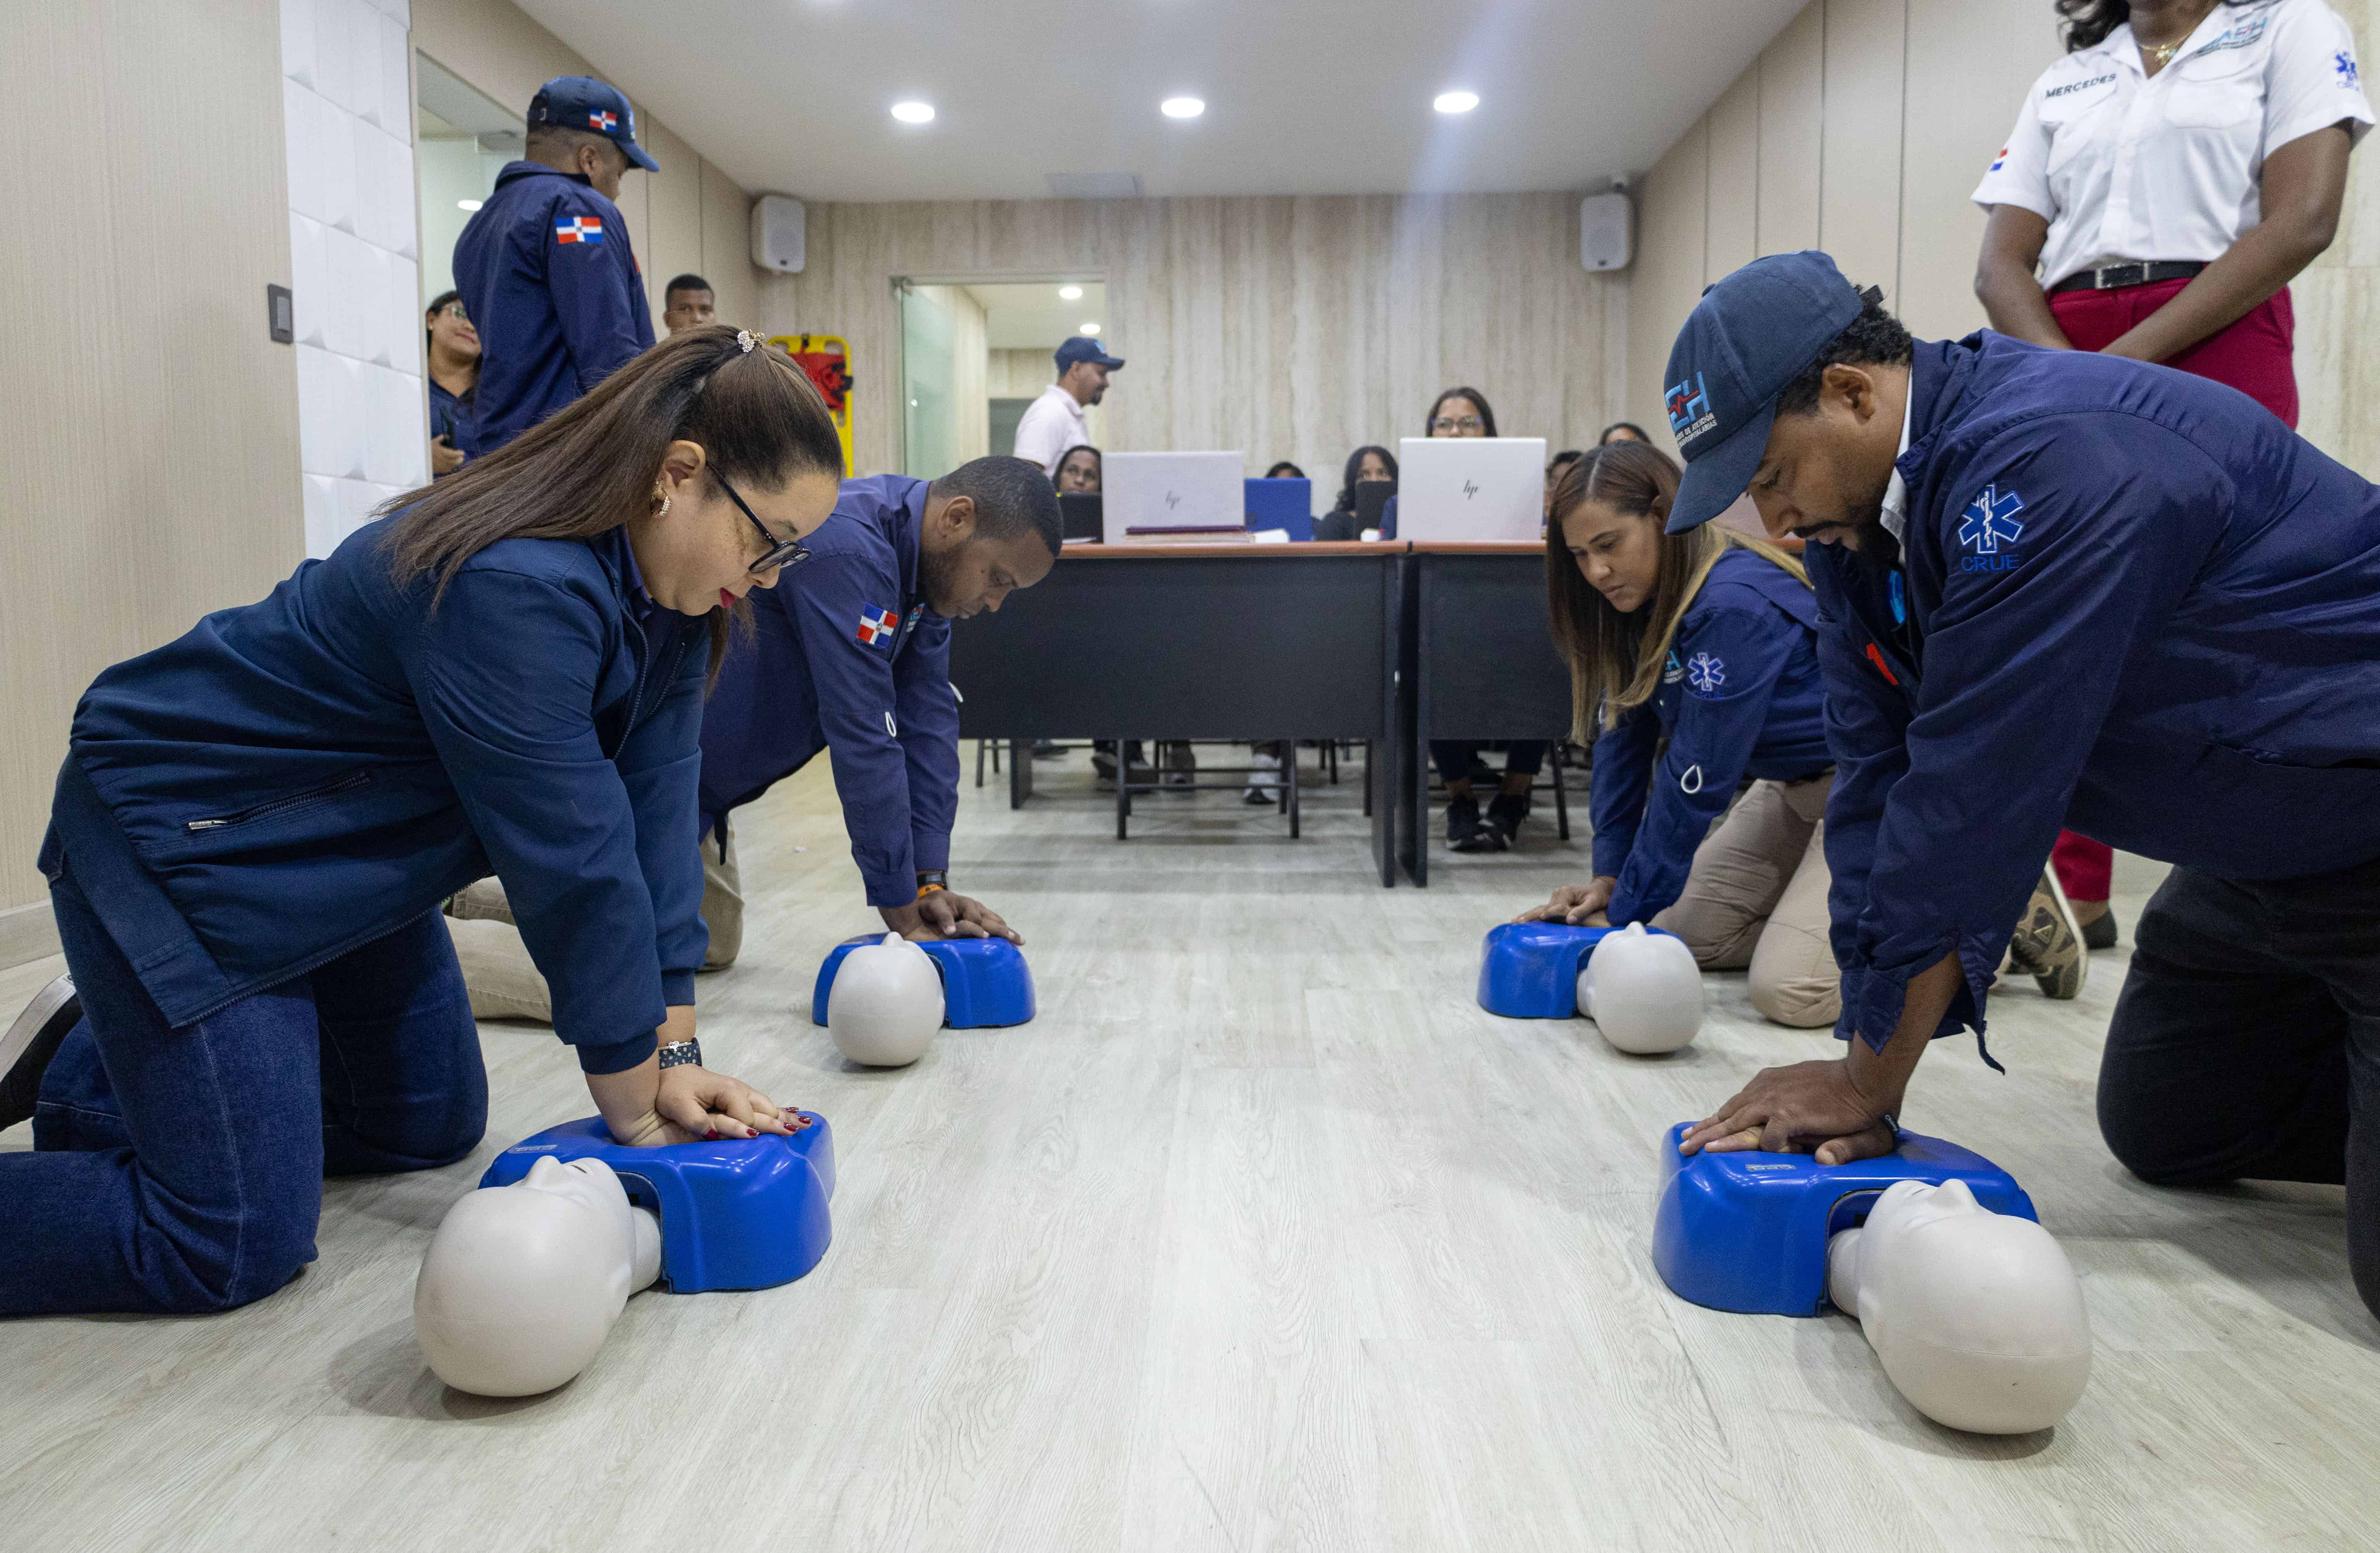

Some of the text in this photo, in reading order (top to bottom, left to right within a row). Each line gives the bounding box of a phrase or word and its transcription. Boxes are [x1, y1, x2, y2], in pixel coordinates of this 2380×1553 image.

[2045, 73, 2116, 100] MERCEDES
[1463, 479, 1479, 501] hp
[1961, 554, 2020, 571] CRUE
